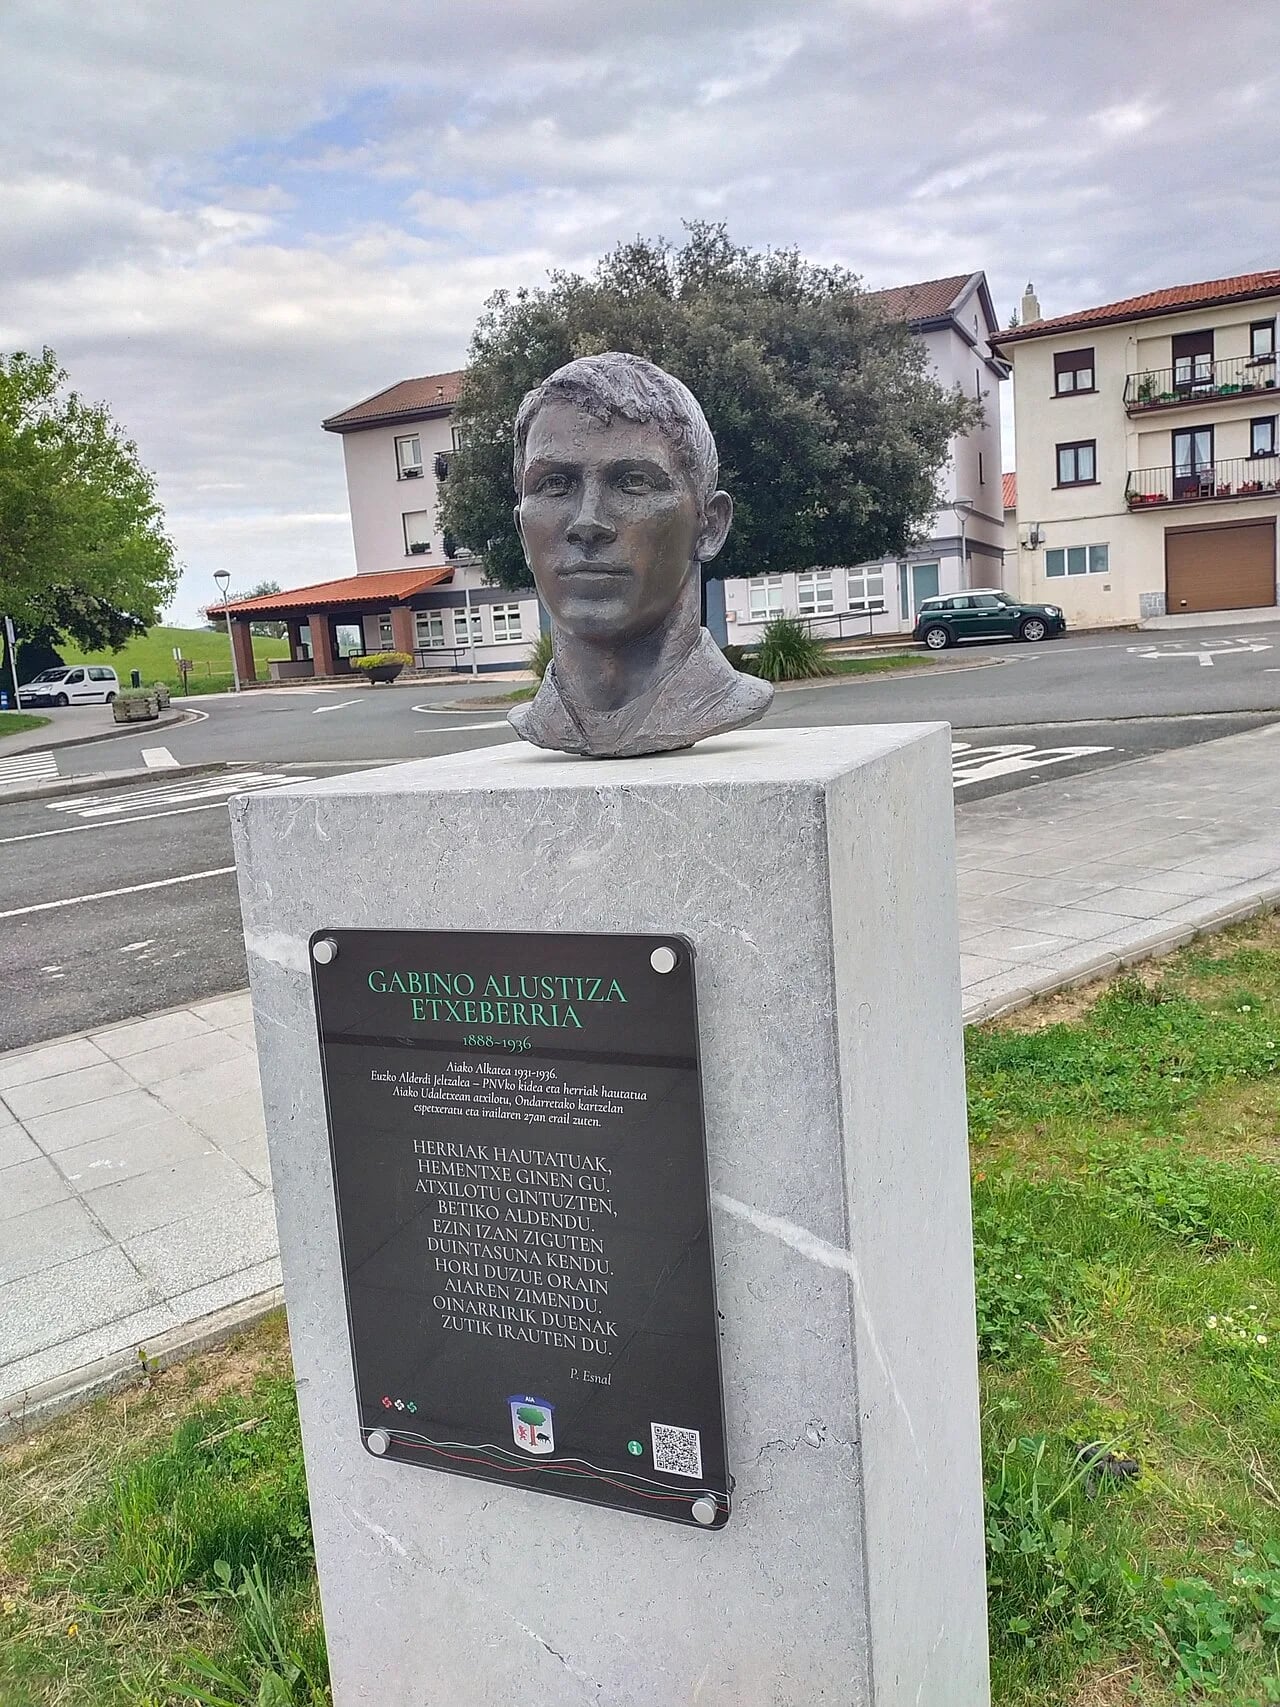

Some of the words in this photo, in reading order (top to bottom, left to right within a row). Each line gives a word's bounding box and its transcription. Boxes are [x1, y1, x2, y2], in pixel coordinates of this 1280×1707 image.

[368, 970, 475, 996] GABINO
[482, 974, 628, 1003] ALUSTIZA
[410, 998, 583, 1029] ETXEBERRIA
[371, 1069, 397, 1082] Euzko
[398, 1071, 431, 1085] Alderdi
[433, 1073, 470, 1088] Jeltzalea
[482, 1077, 516, 1091] PNVko
[518, 1079, 543, 1093] kidea
[545, 1085, 561, 1094] eta
[563, 1082, 599, 1097] herriak
[601, 1085, 647, 1101] hautatua
[446, 1060, 474, 1074] Aiako
[475, 1062, 512, 1076] Alkatea
[514, 1067, 558, 1082] 1931-1936.
[392, 1085, 419, 1098] Aiako
[421, 1087, 471, 1102] Udaletxean
[472, 1091, 512, 1107] atxilotu,
[514, 1094, 576, 1110] Ondarretako
[577, 1098, 624, 1114] kartzelan
[413, 1104, 463, 1116] espetxeratu
[465, 1108, 480, 1117] eta
[481, 1106, 522, 1120] irailaren
[523, 1113, 546, 1125] 27an
[548, 1112, 570, 1125] erail
[572, 1117, 602, 1127] zuten.
[413, 1139, 490, 1161] HERRIAK
[493, 1146, 612, 1176] HAUTATUAK,
[417, 1158, 512, 1182] HEMENTXE
[516, 1168, 573, 1189] GINEN
[578, 1175, 610, 1193] GU.
[415, 1178, 501, 1202] ATXILOTU
[505, 1188, 618, 1218] GINTUZTEN,
[437, 1199, 500, 1220] BETIKO
[504, 1207, 595, 1232] ALDENDU.
[432, 1218, 471, 1237] EZIN
[475, 1223, 518, 1243] IZAN
[522, 1229, 604, 1254] ZIGUTEN
[427, 1236, 543, 1266] DUINTASUNA
[546, 1252, 614, 1276] KENDU.
[435, 1257, 479, 1277] HORI
[484, 1263, 543, 1286] DUZUE
[547, 1273, 608, 1295] ORAIN
[444, 1278, 510, 1300] AIAREN
[514, 1287, 602, 1314] ZIMENDU.
[432, 1295, 537, 1325] OINARRIRIK
[541, 1311, 618, 1337] DUENAK
[441, 1314, 493, 1336] ZUTIK
[497, 1323, 576, 1350] IRAUTEN
[581, 1336, 612, 1356] DU.
[570, 1367, 579, 1380] P.
[582, 1370, 612, 1386] Esnal
